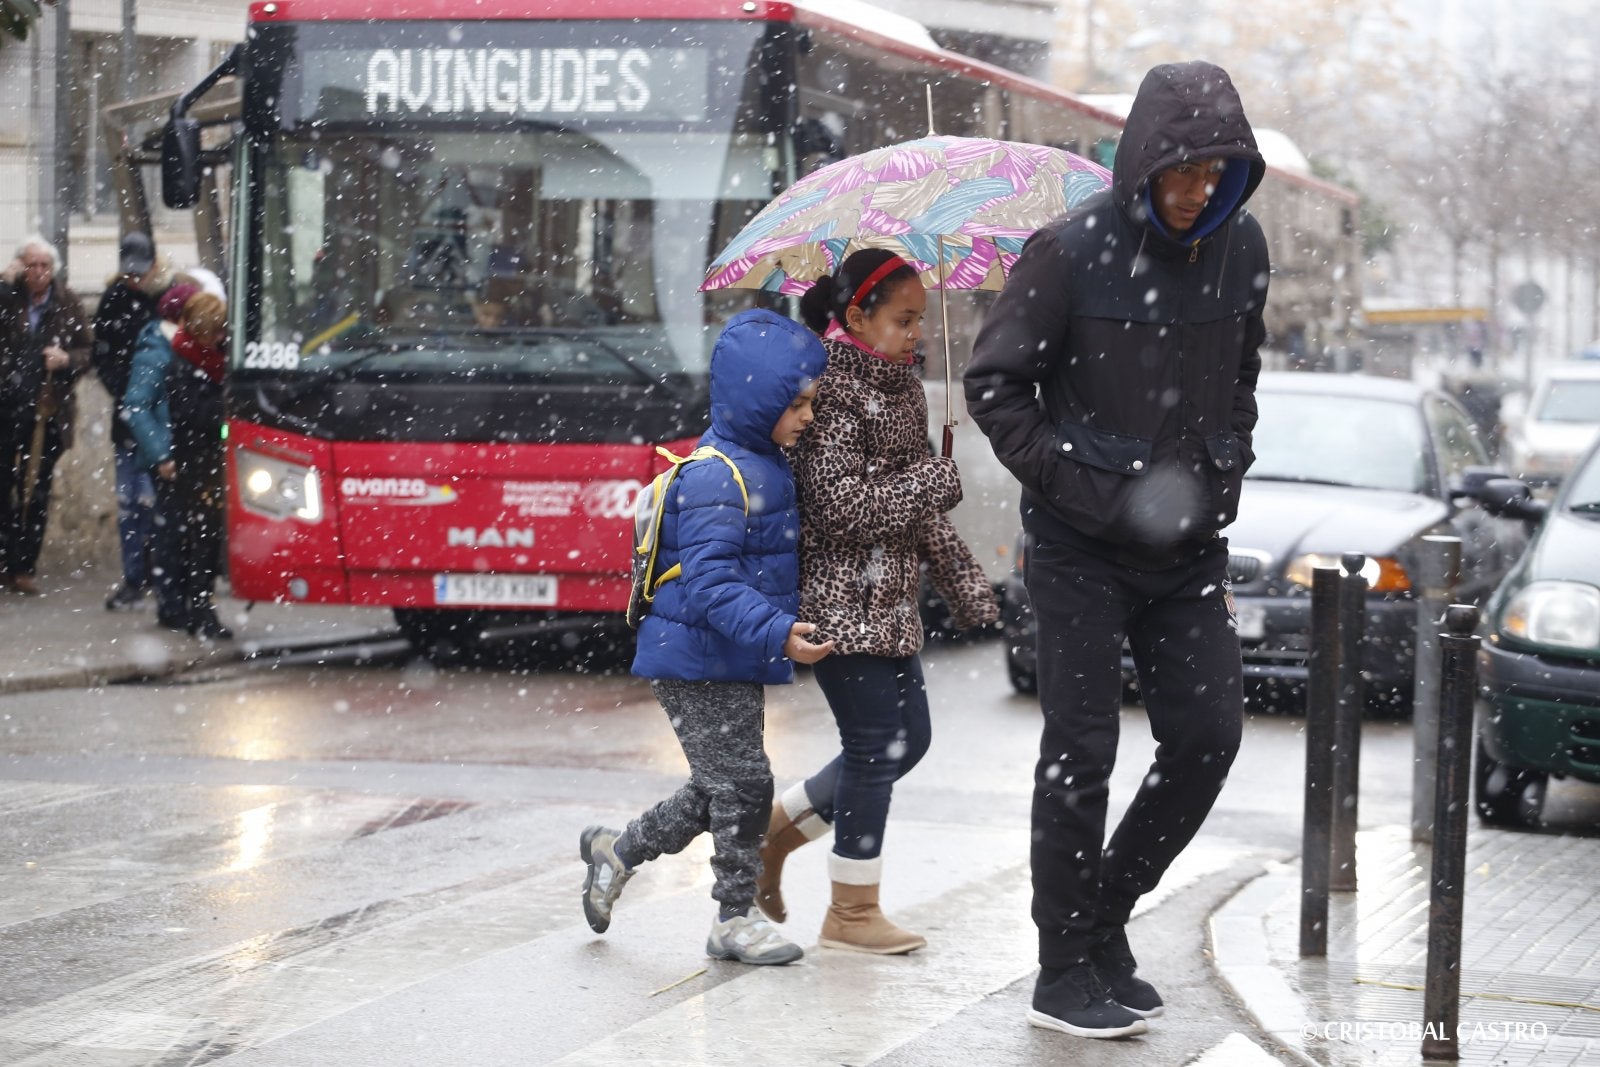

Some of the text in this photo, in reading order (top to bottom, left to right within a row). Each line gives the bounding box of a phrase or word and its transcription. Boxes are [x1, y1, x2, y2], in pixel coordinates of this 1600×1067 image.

[365, 48, 651, 113] AVINGUDES
[244, 341, 300, 370] 2336
[447, 526, 535, 549] MAN
